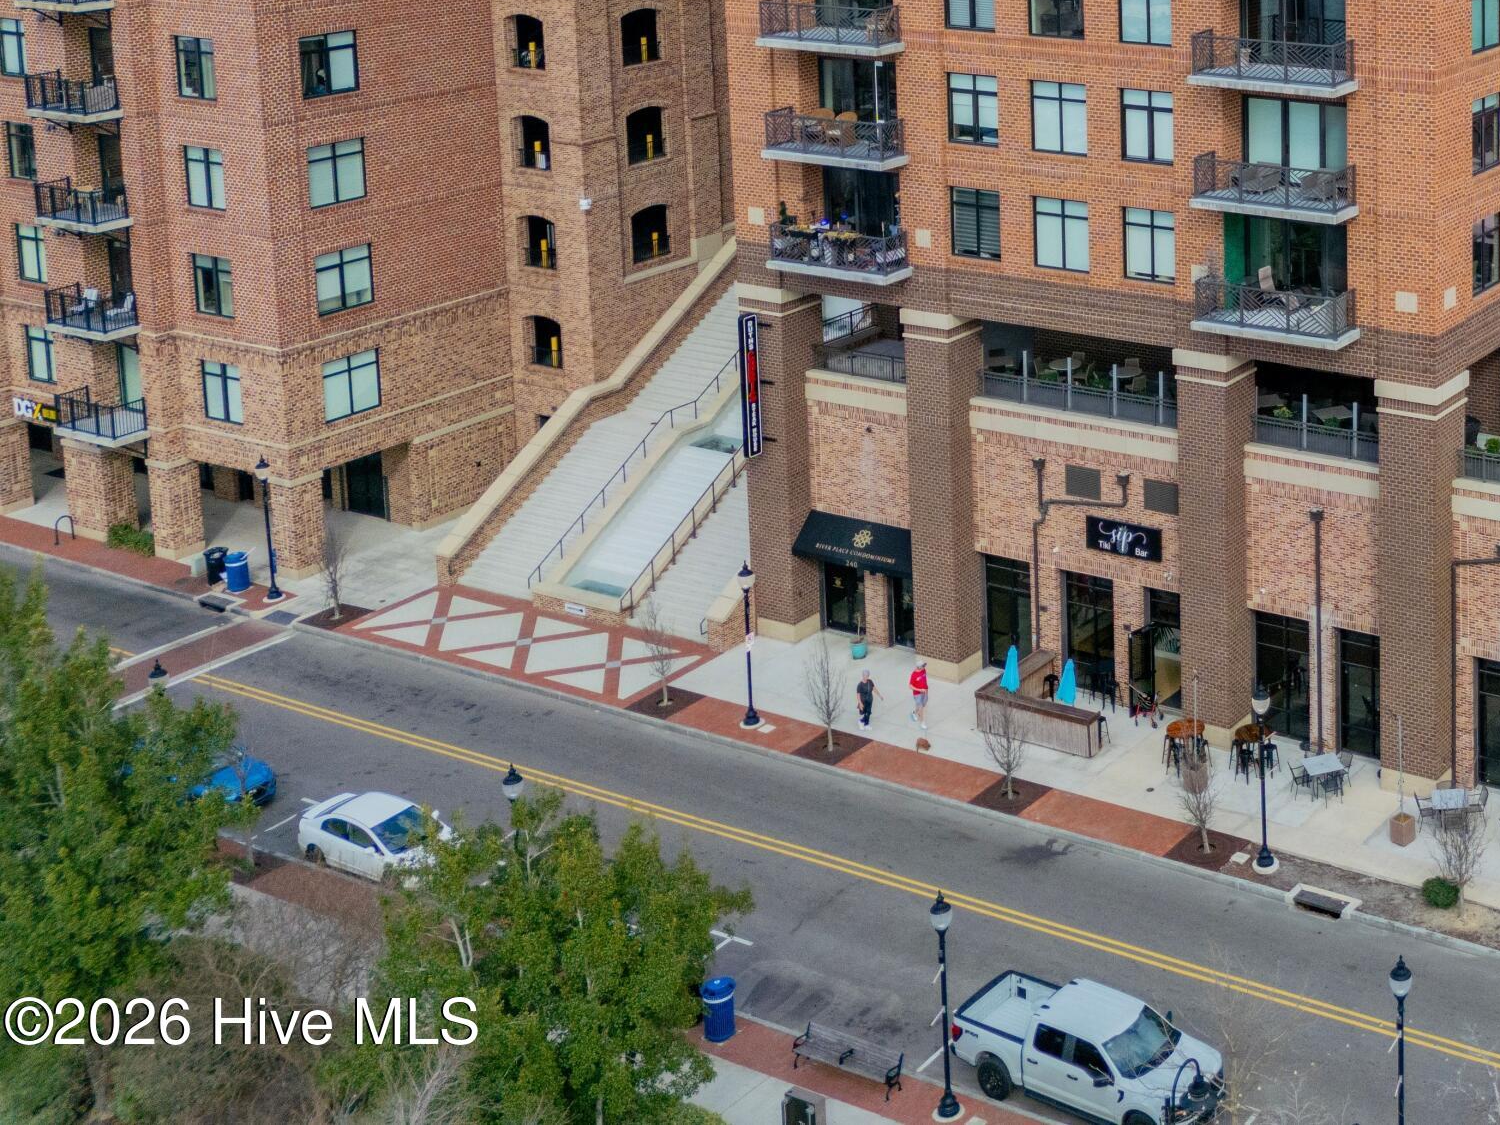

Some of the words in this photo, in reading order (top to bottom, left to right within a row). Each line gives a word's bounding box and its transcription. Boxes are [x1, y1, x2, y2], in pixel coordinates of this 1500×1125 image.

[815, 542, 832, 551] RIVER
[832, 546, 849, 555] PLACE
[1098, 539, 1111, 551] Tiki
[1135, 547, 1148, 558] Bar
